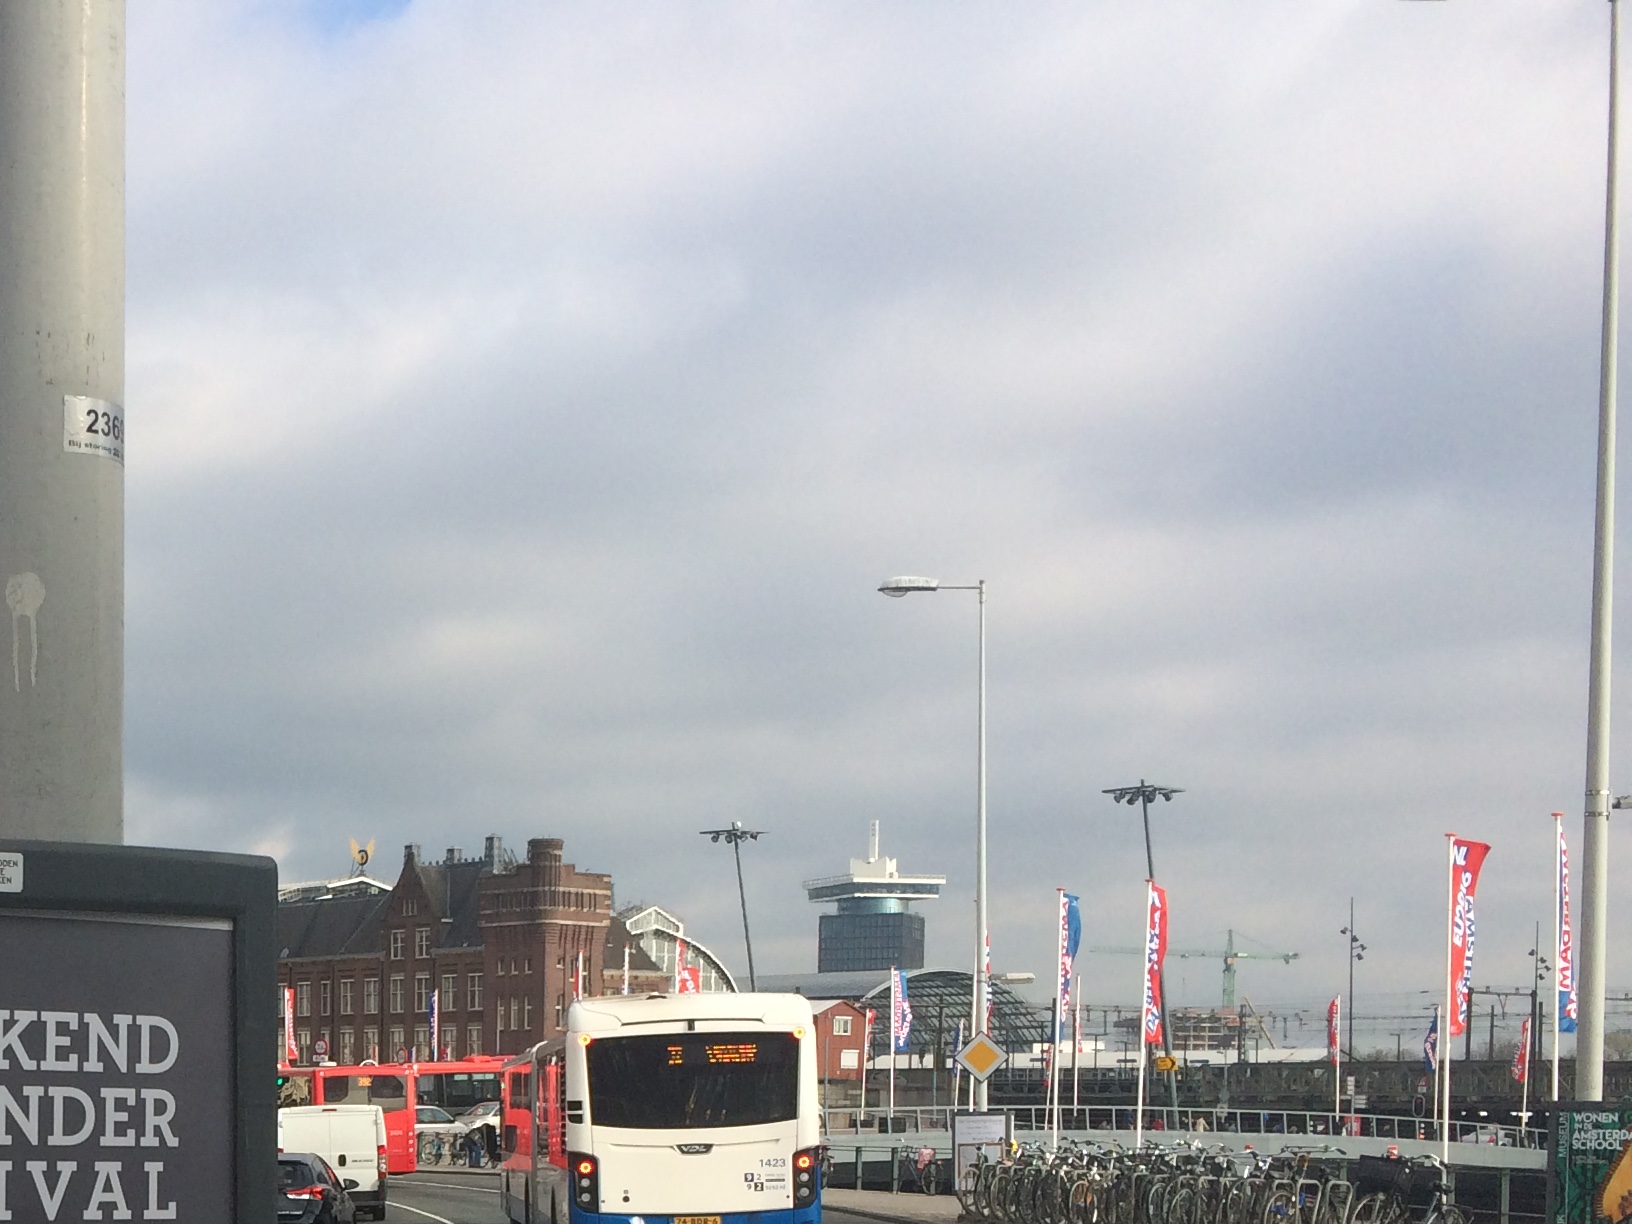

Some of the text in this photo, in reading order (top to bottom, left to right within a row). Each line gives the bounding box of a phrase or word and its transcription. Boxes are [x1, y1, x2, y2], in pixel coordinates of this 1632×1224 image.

[1573, 1112, 1619, 1123] WONEN
[1558, 1111, 1568, 1158] MUSEUM
[680, 1144, 708, 1153] VDL
[1572, 1139, 1623, 1151] SCHOOL
[758, 1158, 787, 1168] 1423
